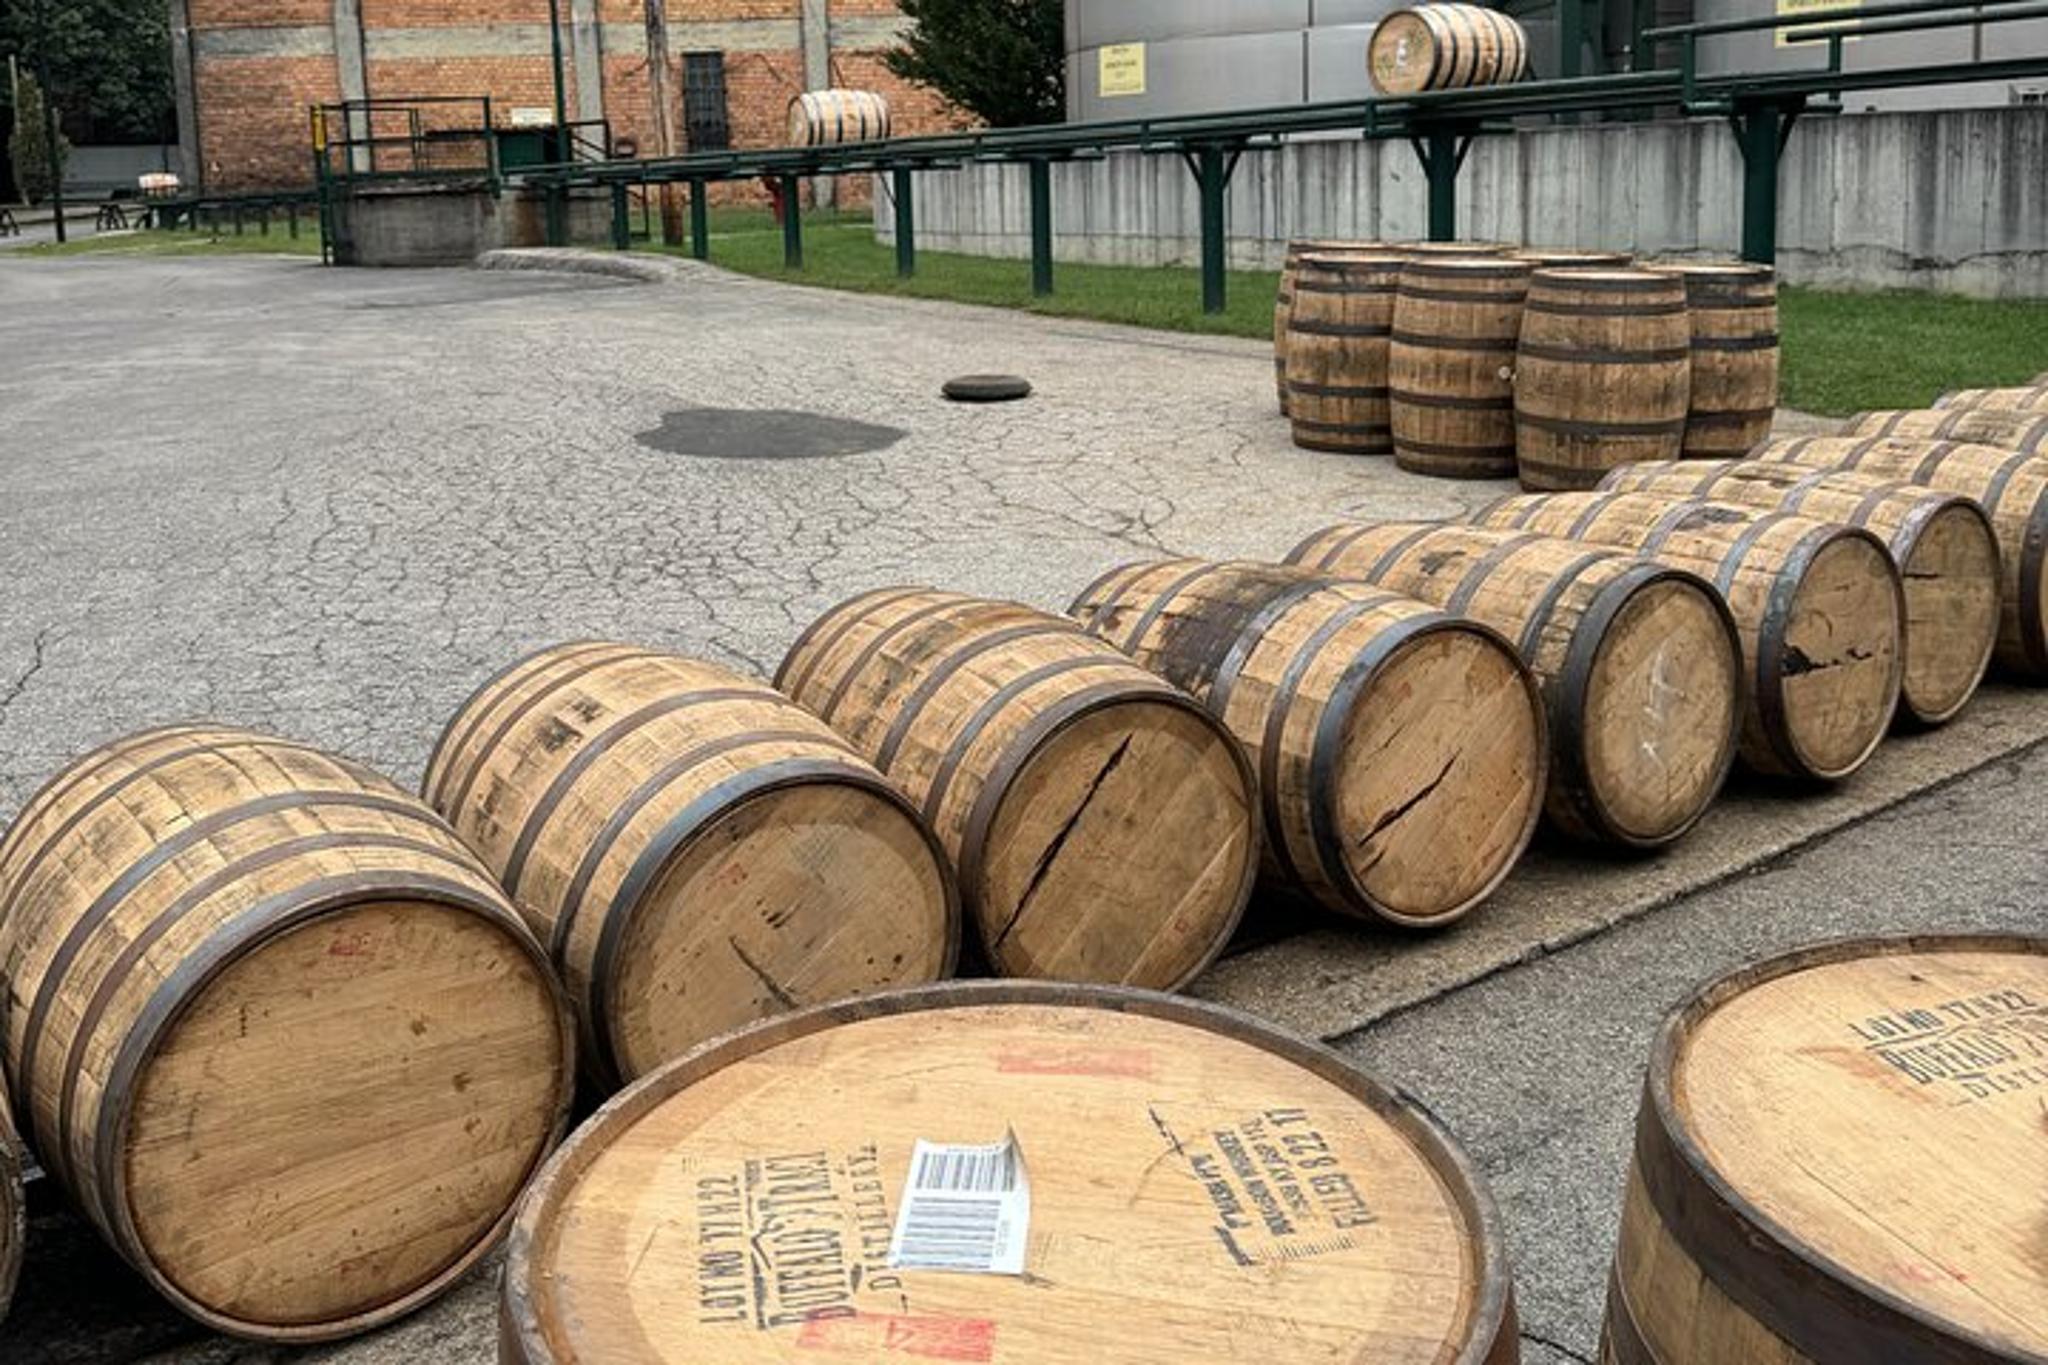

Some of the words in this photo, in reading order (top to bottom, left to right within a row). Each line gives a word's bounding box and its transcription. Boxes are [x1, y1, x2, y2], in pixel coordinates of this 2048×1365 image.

[698, 1251, 743, 1280] NO
[768, 1228, 857, 1327] BUFFALO
[700, 1284, 747, 1323] LOT
